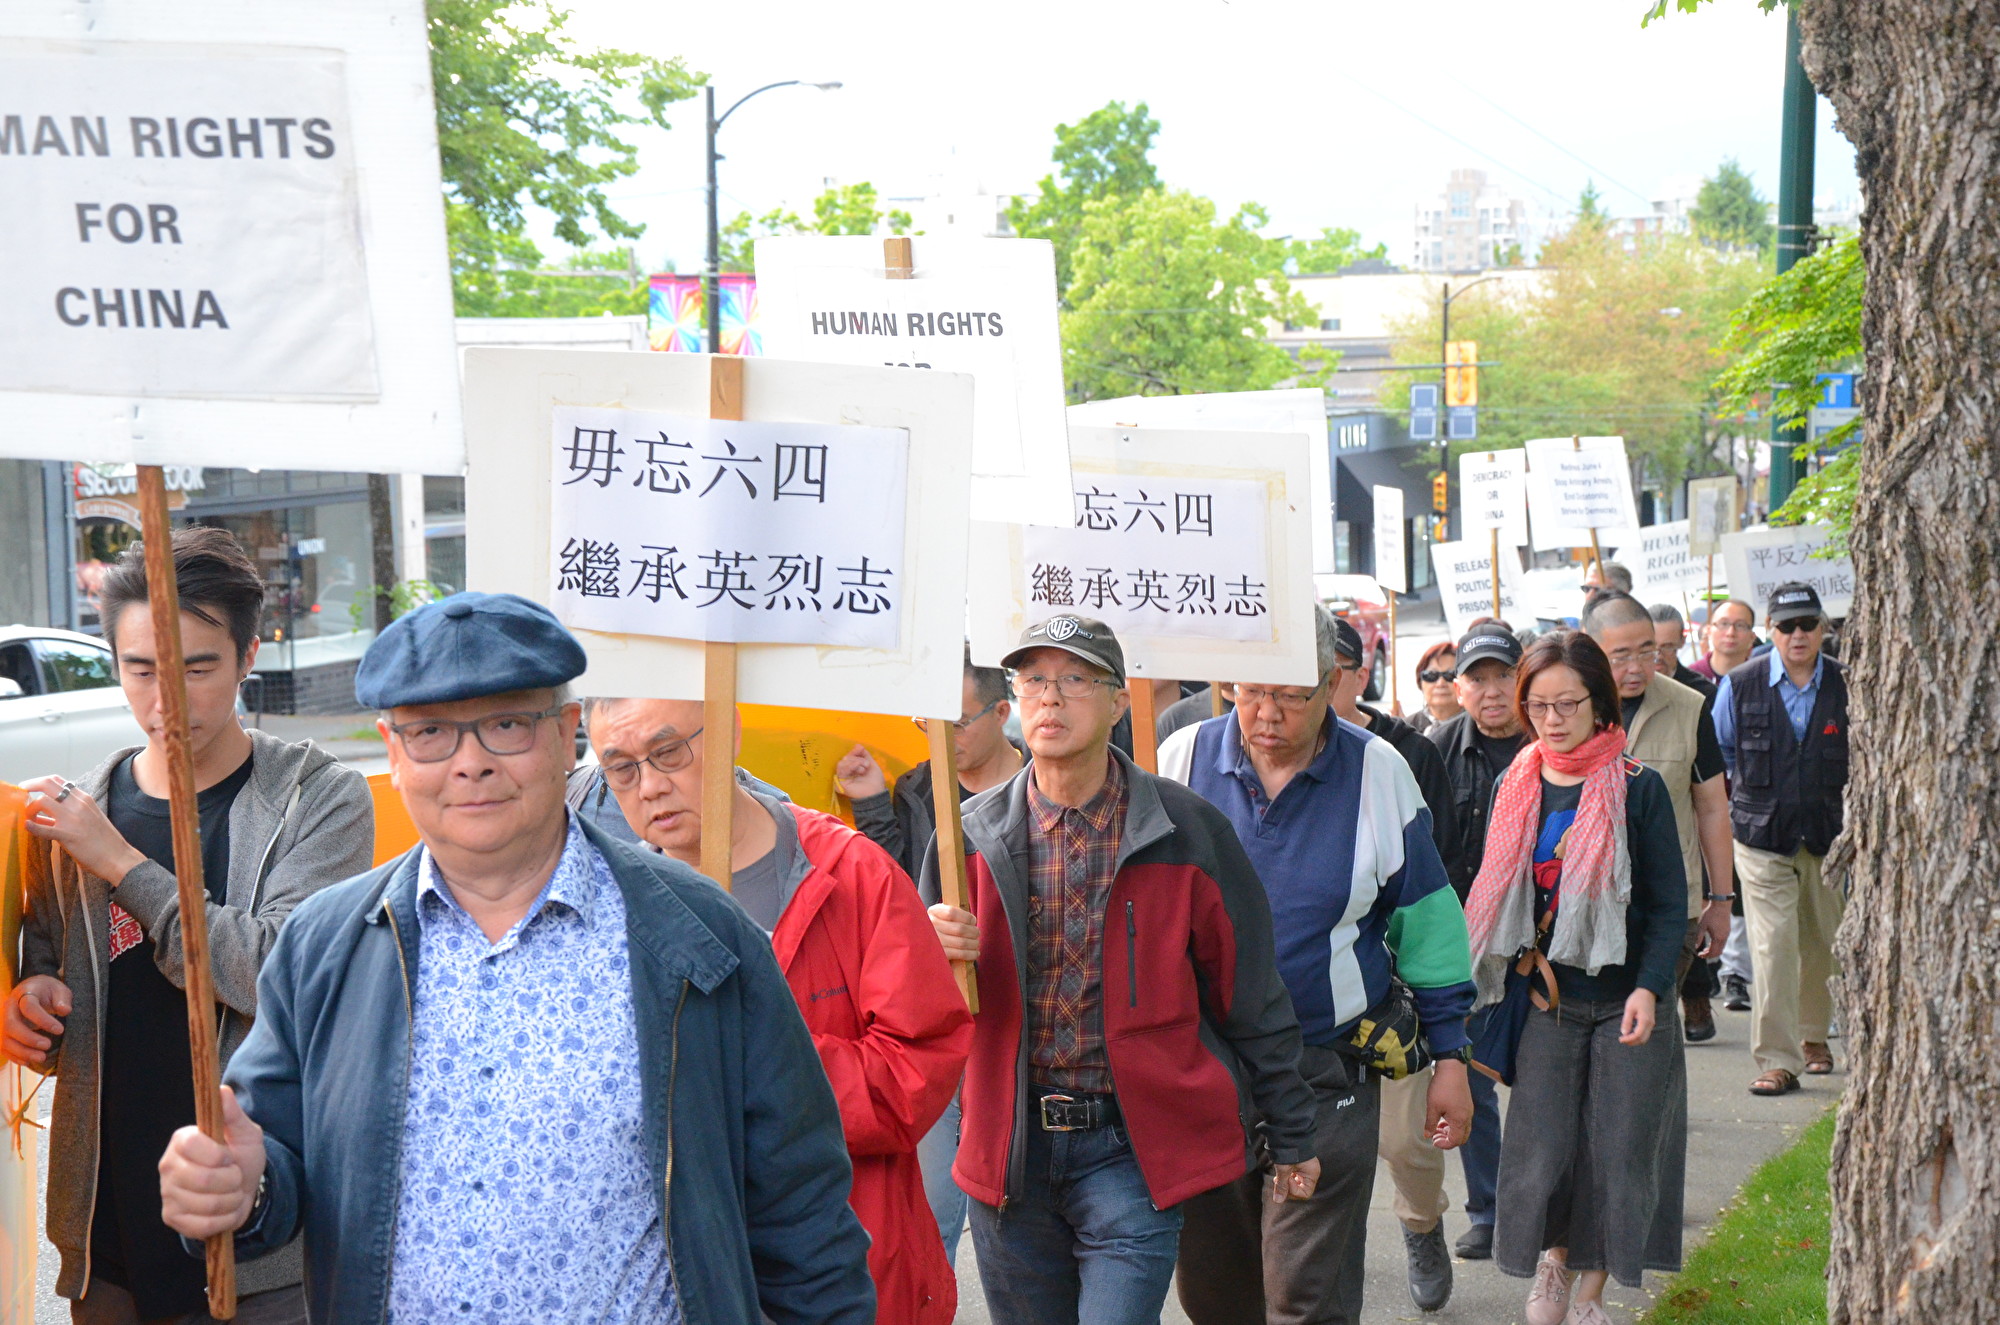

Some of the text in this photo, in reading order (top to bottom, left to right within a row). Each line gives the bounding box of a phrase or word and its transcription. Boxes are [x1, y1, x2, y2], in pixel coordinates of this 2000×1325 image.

[129, 116, 336, 160] RIGHTS
[74, 202, 183, 245] FOR
[54, 286, 230, 330] CHINA
[811, 311, 1004, 338] HUMAN RIGHTS
[562, 425, 829, 504] 毋忘六四
[162, 465, 206, 491] OOK
[1076, 485, 1213, 537] 忘六四
[1643, 533, 1690, 552] HUMA
[1454, 558, 1493, 573] RELEAS
[1647, 551, 1706, 570] RIGH
[1752, 543, 1845, 569] 平反六
[556, 537, 893, 616] 繼承英烈志
[1031, 562, 1267, 618] 繼承英烈志
[1458, 596, 1514, 613] PRISONRS
[1050, 620, 1074, 639] WB
[1336, 1095, 1355, 1110] FILA
